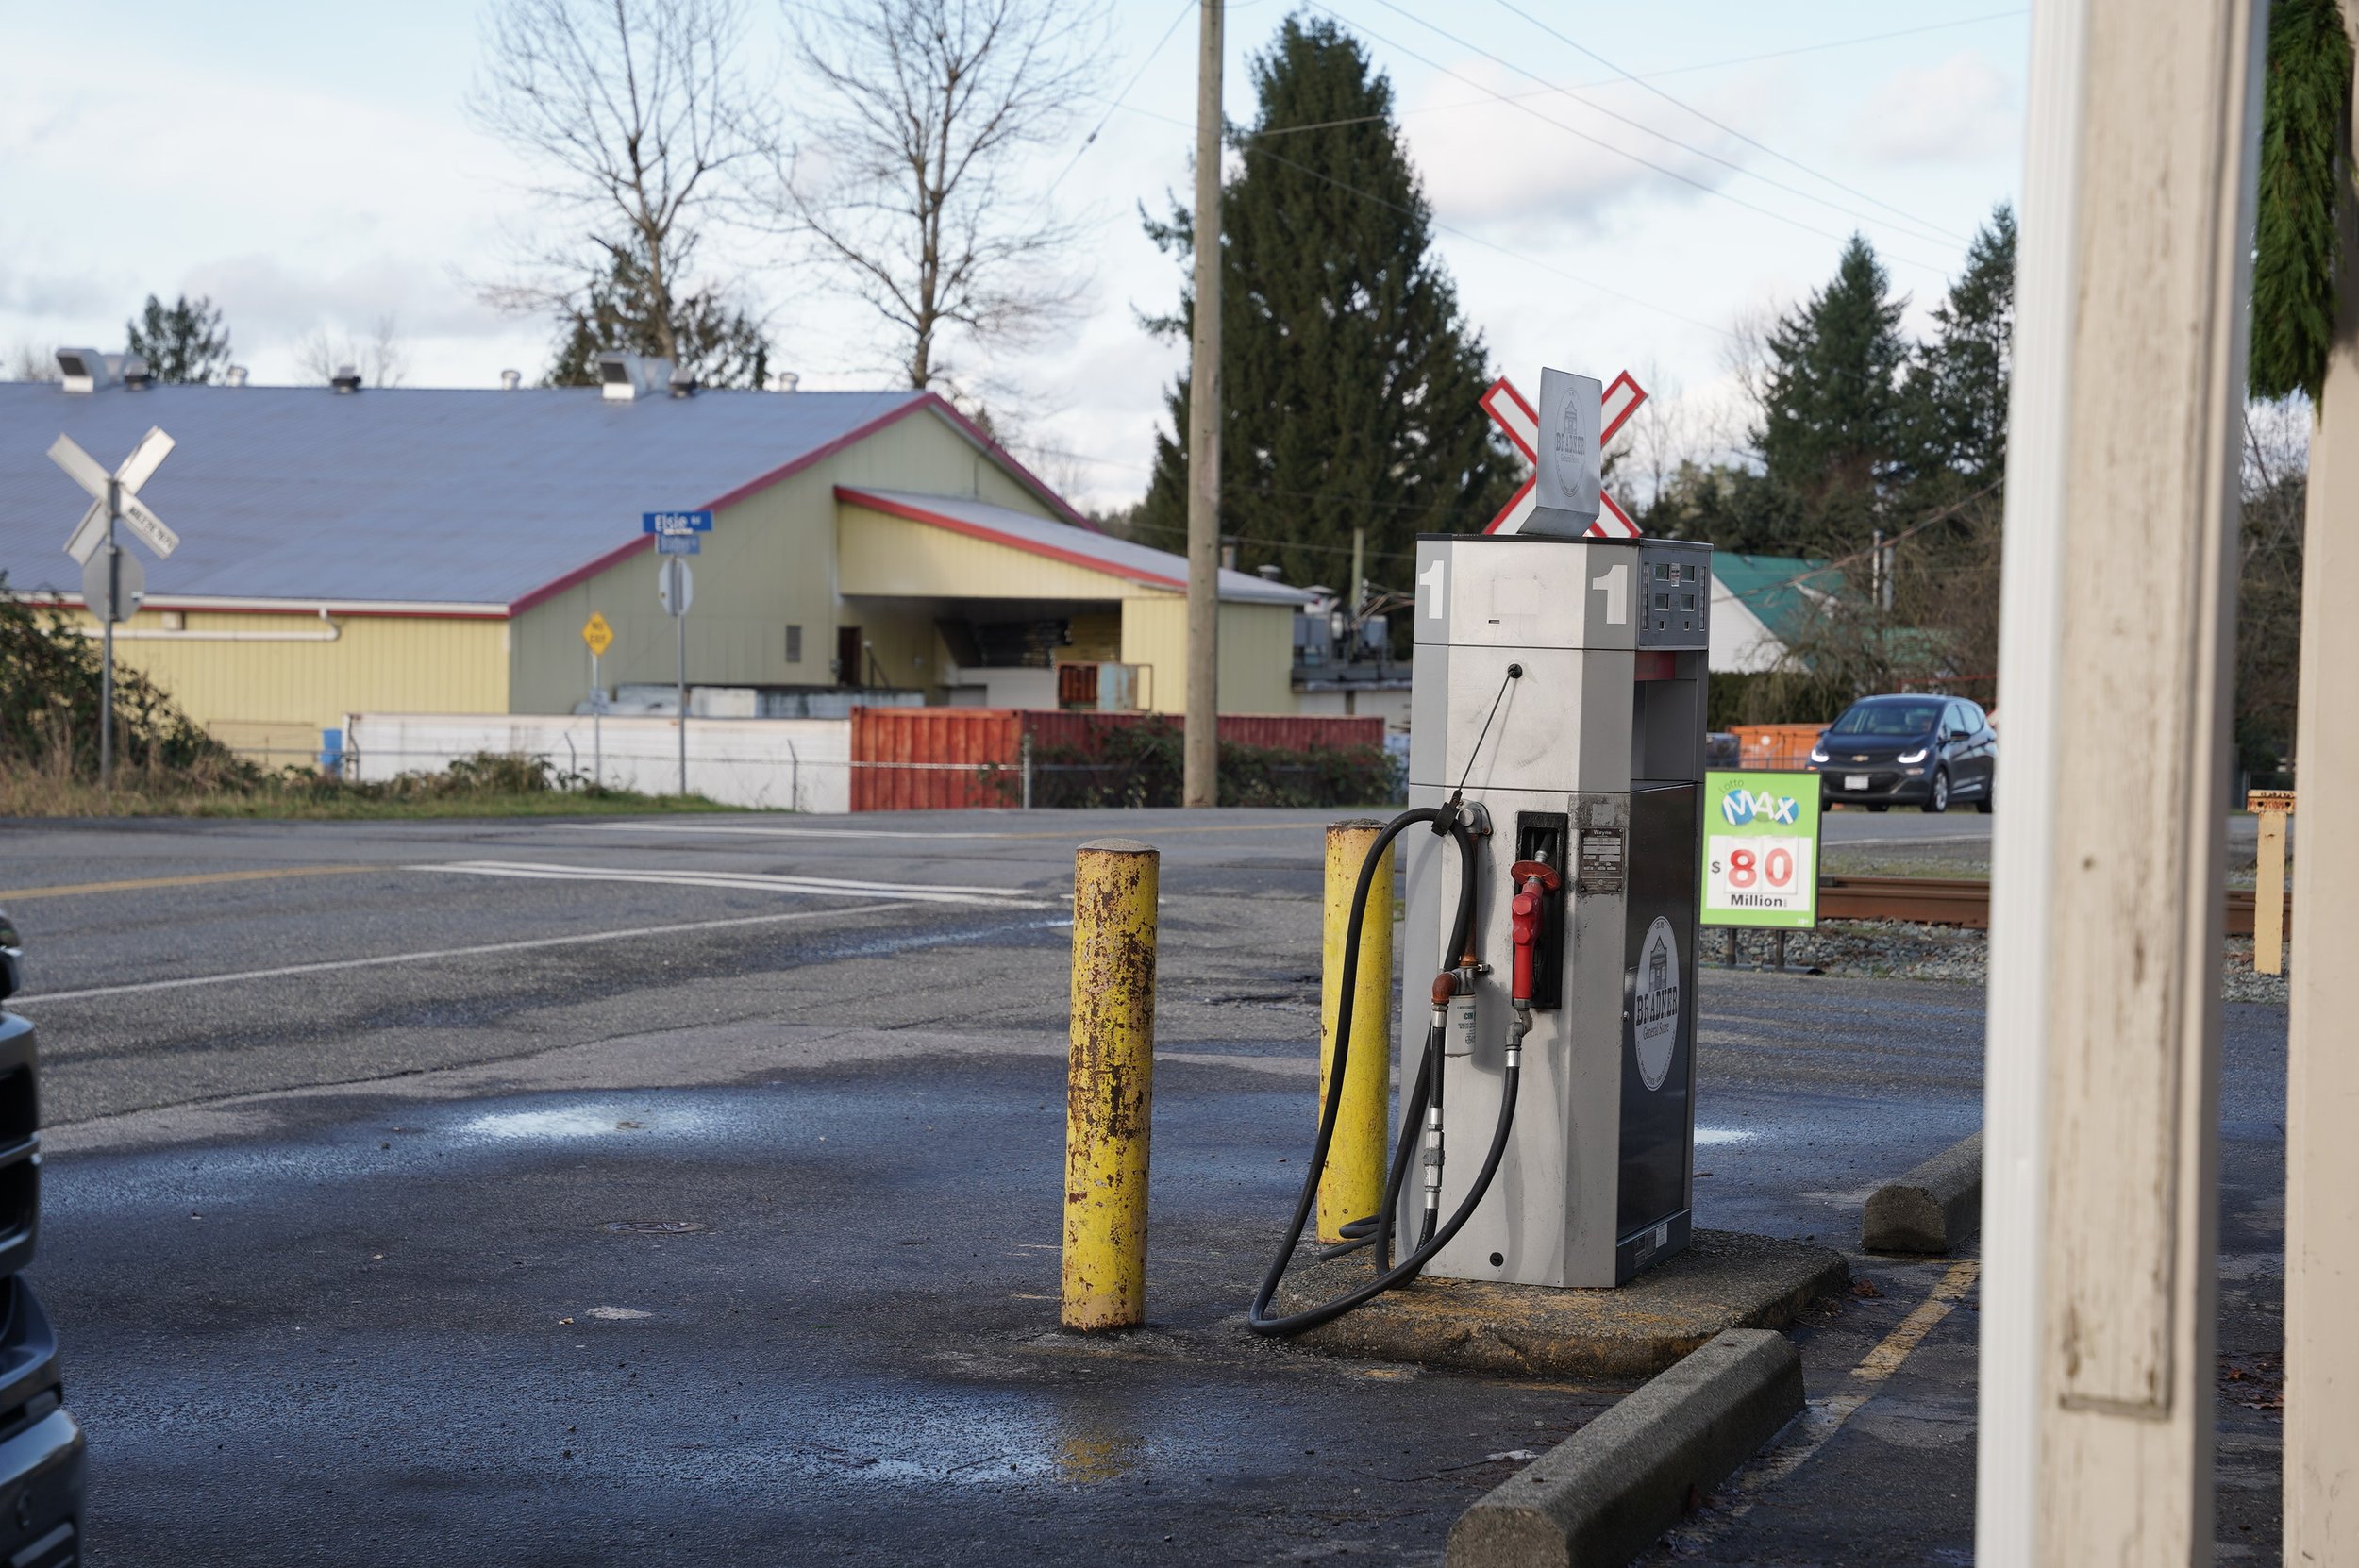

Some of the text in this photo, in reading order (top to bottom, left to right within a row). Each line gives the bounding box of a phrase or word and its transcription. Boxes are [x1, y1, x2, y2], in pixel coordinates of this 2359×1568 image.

[1556, 432, 1585, 455] BRADNER
[654, 513, 688, 532] Elsie
[1419, 560, 1445, 619] 1
[1592, 564, 1628, 625] 1
[1718, 778, 1745, 793] Lotto
[1722, 789, 1797, 826] MAX
[1711, 847, 1793, 889] $ 80
[1731, 894, 1782, 908] Million
[1636, 986, 1678, 1026] BRADNER
[1643, 1022, 1670, 1041] General Store
